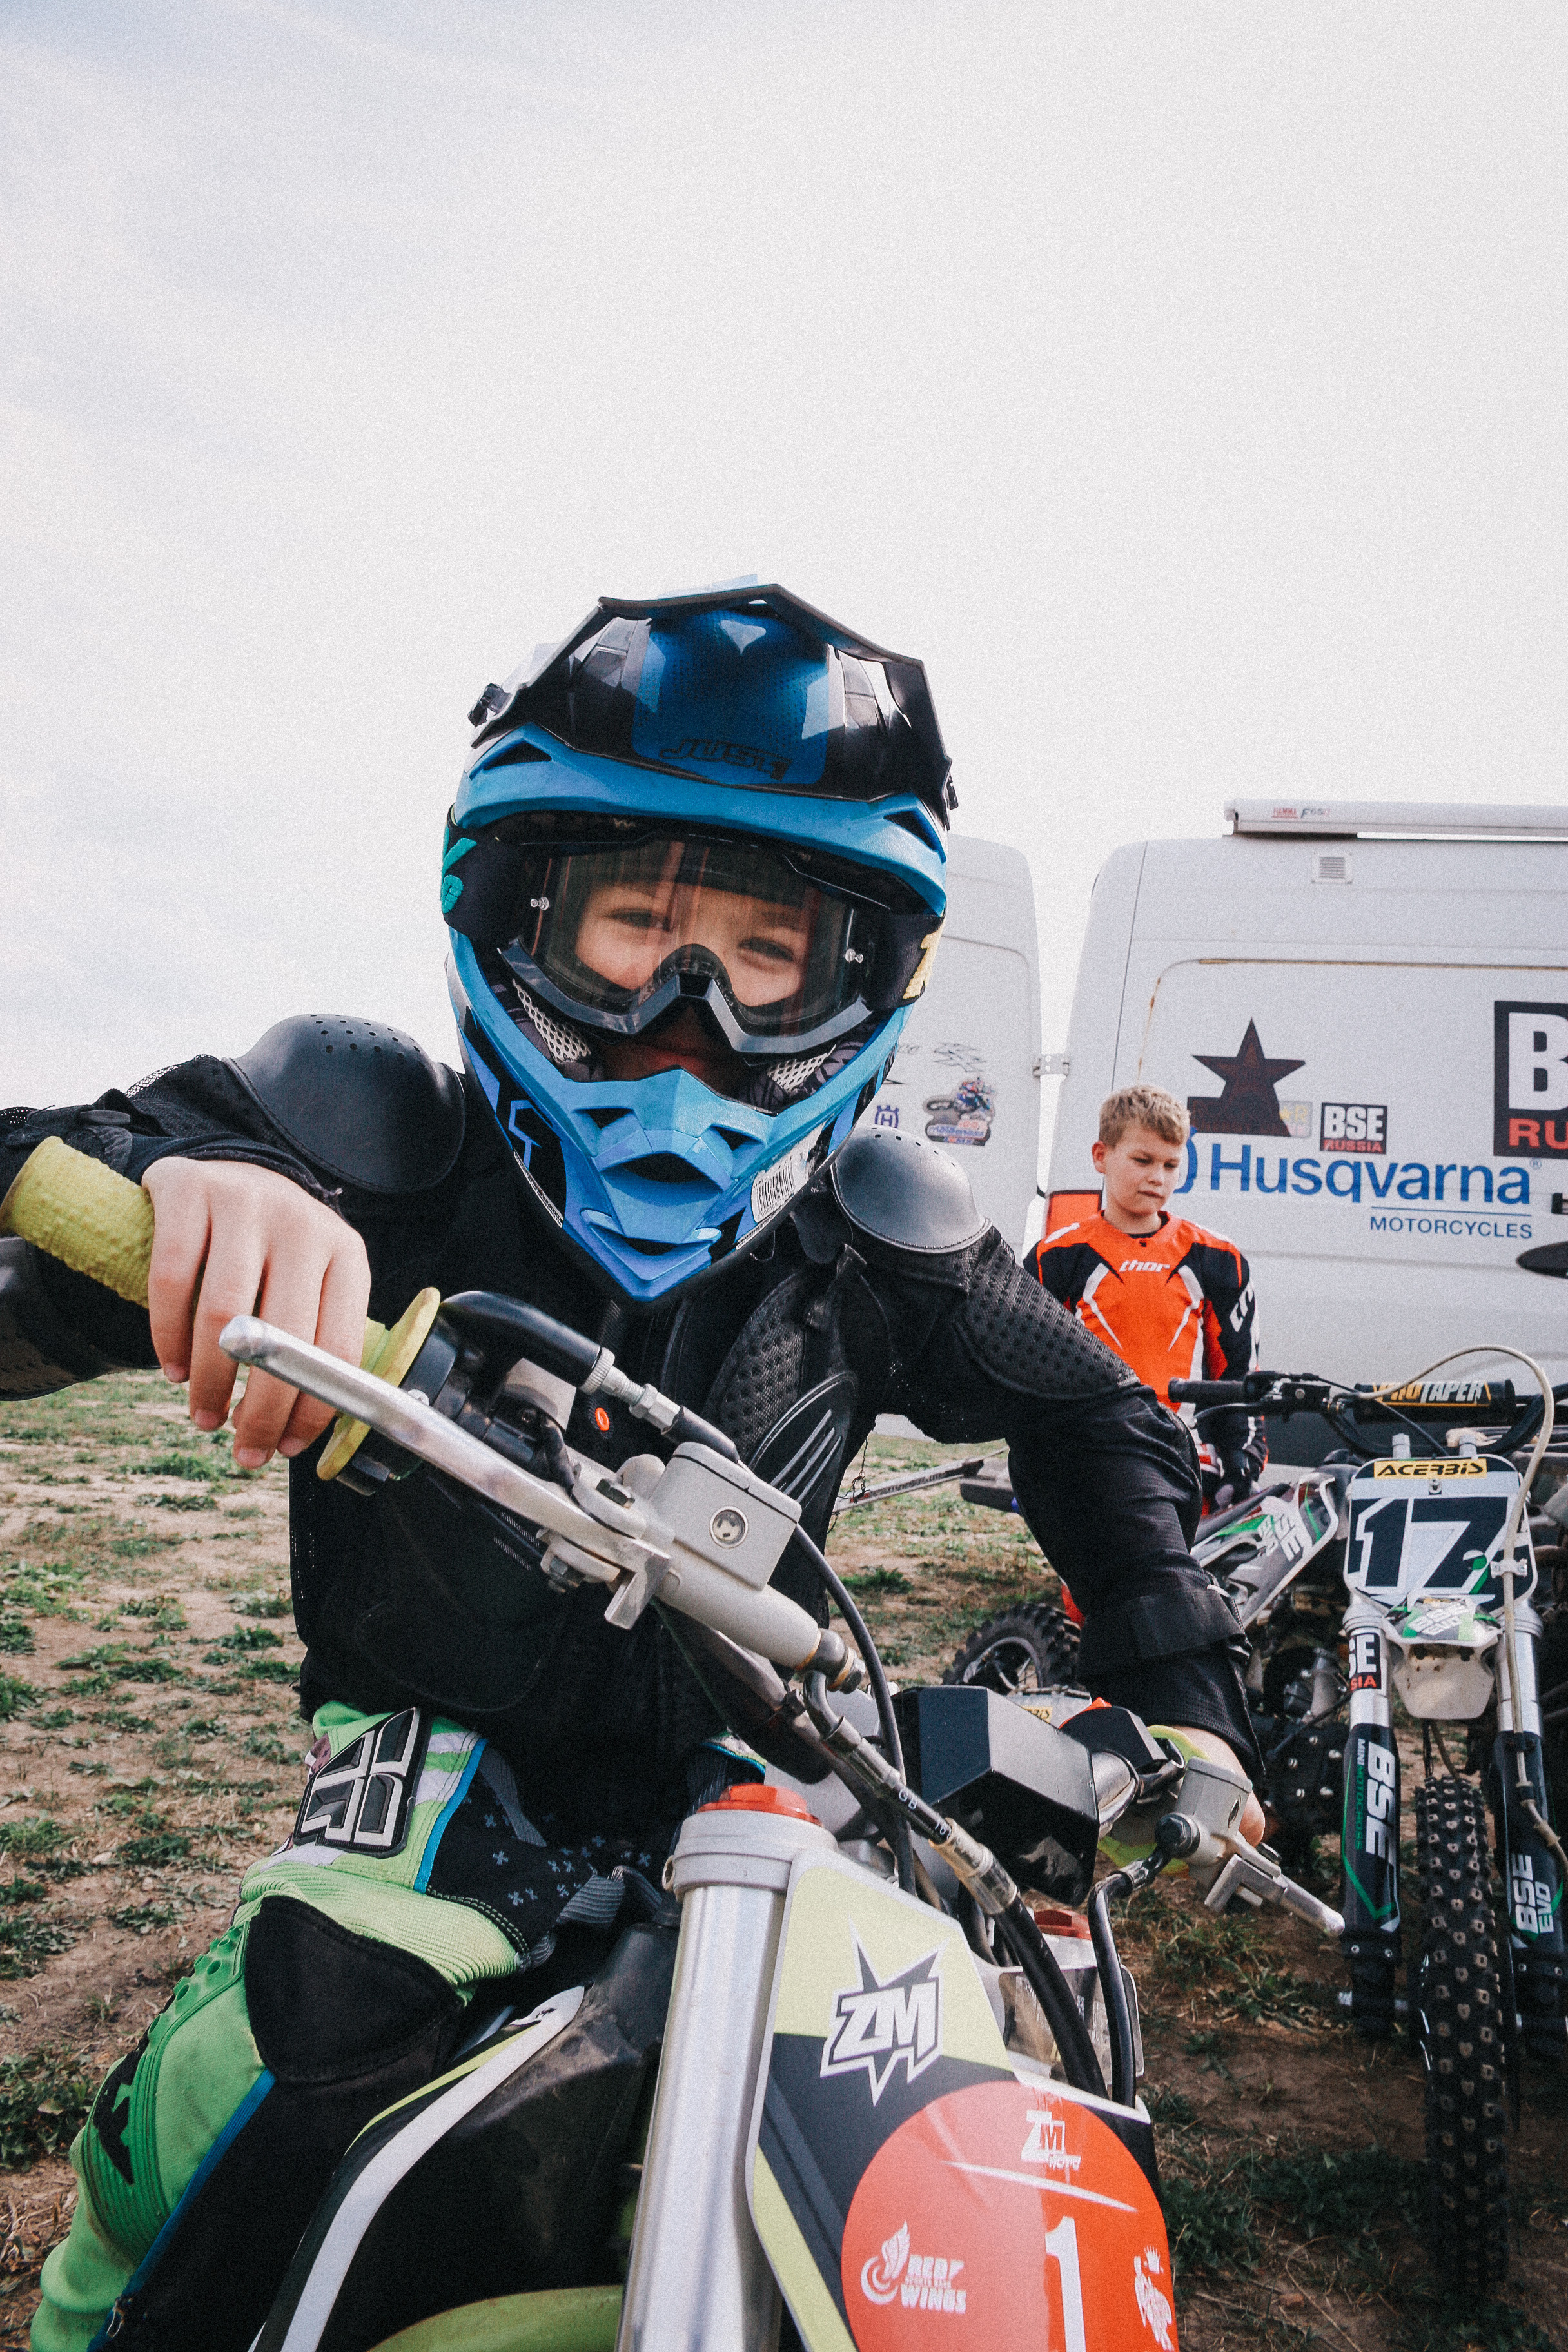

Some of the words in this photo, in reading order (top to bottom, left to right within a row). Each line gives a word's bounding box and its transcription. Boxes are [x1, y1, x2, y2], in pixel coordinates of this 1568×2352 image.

[1323, 1139, 1383, 1153] RUSSIA
[1324, 1105, 1385, 1141] BSE
[1211, 1143, 1530, 1204] Husqvarna
[1370, 1217, 1533, 1239] MOTORCYCLES
[1119, 1259, 1170, 1273] thor
[1362, 1496, 1509, 1588] 17
[1355, 1765, 1364, 1850] MOTOCROSS
[1366, 1741, 1396, 1862] BSE
[1511, 1854, 1538, 1934] BSE
[1535, 1881, 1554, 1933] EVO
[833, 1982, 936, 2061] ZM
[901, 2283, 966, 2314] WINGS
[1045, 2216, 1086, 2352] 1
